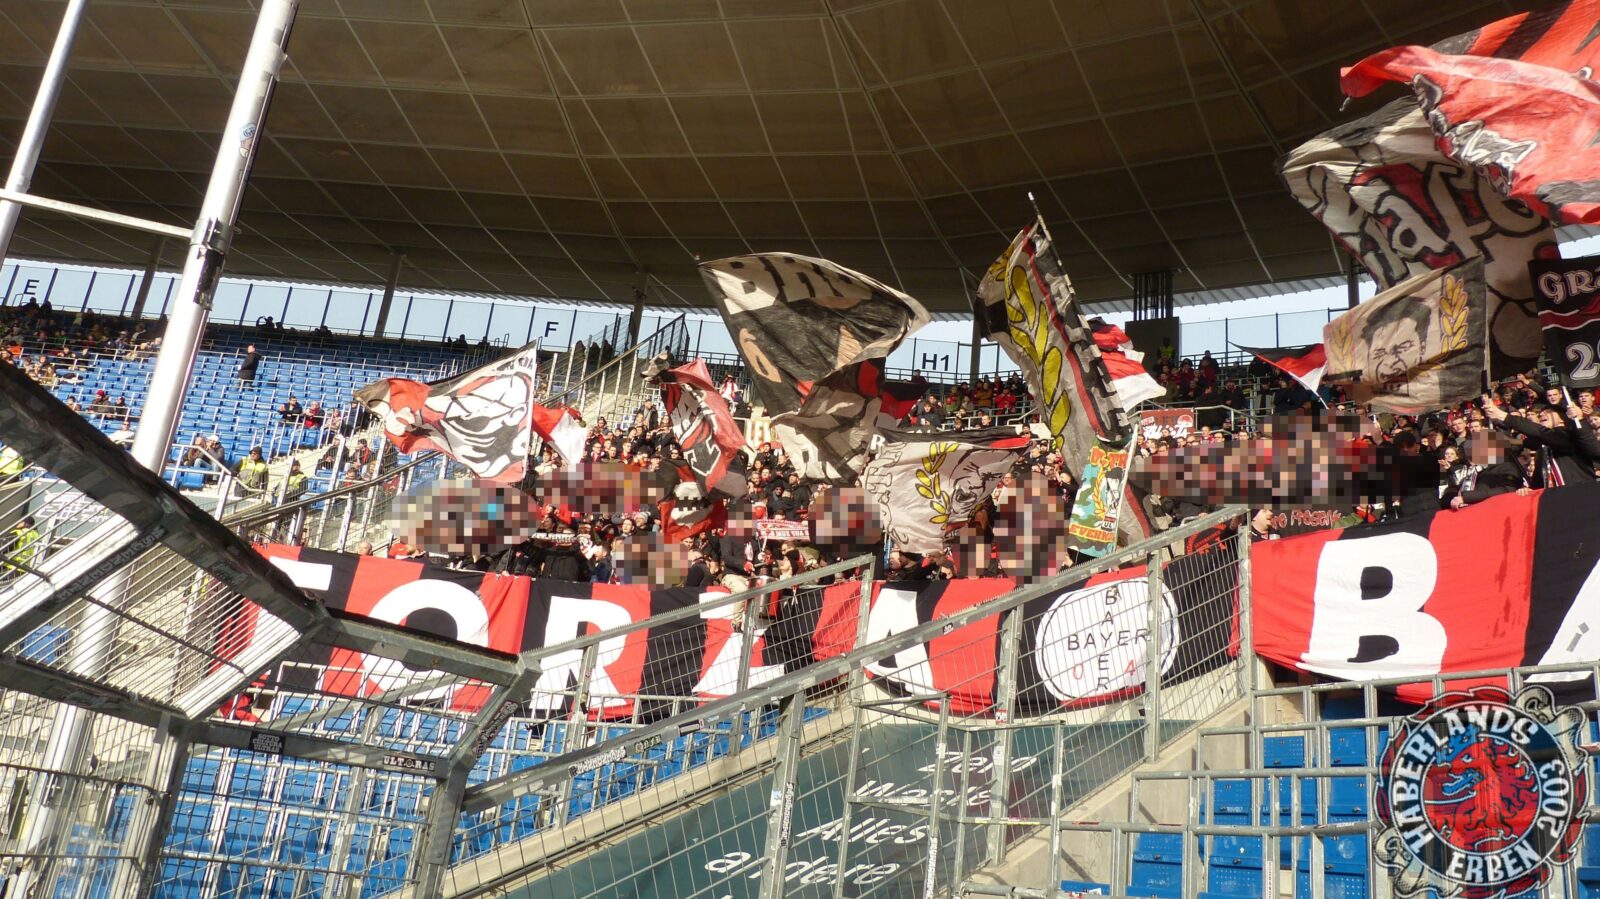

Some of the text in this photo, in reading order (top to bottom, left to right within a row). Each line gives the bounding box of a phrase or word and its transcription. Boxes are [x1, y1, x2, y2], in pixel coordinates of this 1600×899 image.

[24, 279, 40, 295] E
[1538, 269, 1600, 304] GR
[544, 321, 559, 337] F
[922, 353, 950, 371] H1
[1566, 341, 1600, 380] 2
[1068, 627, 1149, 651] BAYER
[795, 817, 931, 844] Alles
